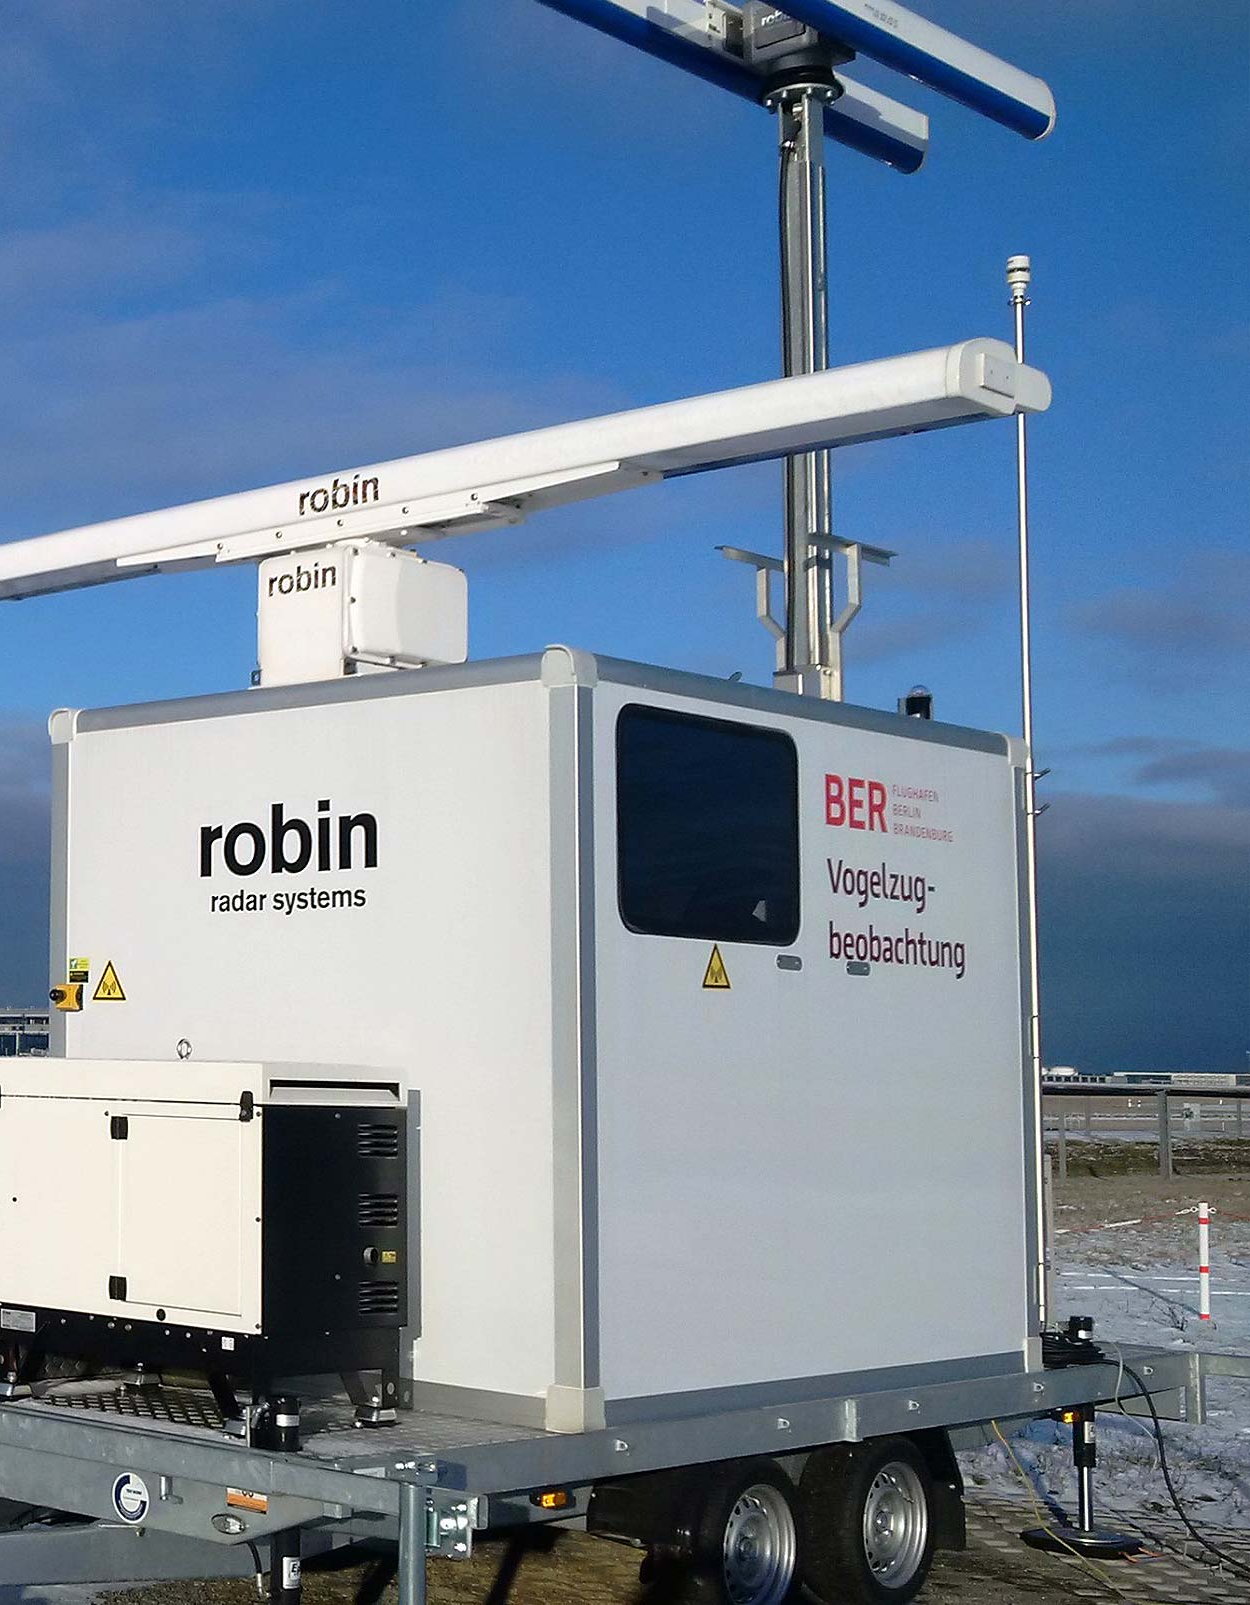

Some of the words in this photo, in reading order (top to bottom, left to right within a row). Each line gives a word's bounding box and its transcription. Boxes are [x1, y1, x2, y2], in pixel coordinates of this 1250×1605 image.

[298, 473, 379, 516] robin
[268, 562, 337, 597] robin
[824, 773, 889, 833] BER
[892, 784, 940, 802] FLUGHAFEN
[892, 803, 921, 818] BERLIN
[200, 799, 378, 877] robin
[893, 823, 954, 843] BRANDENBURG
[211, 889, 267, 913] radar
[272, 887, 367, 916] systems
[826, 857, 936, 914] Vogelzug-
[829, 920, 966, 980] beobachtung
